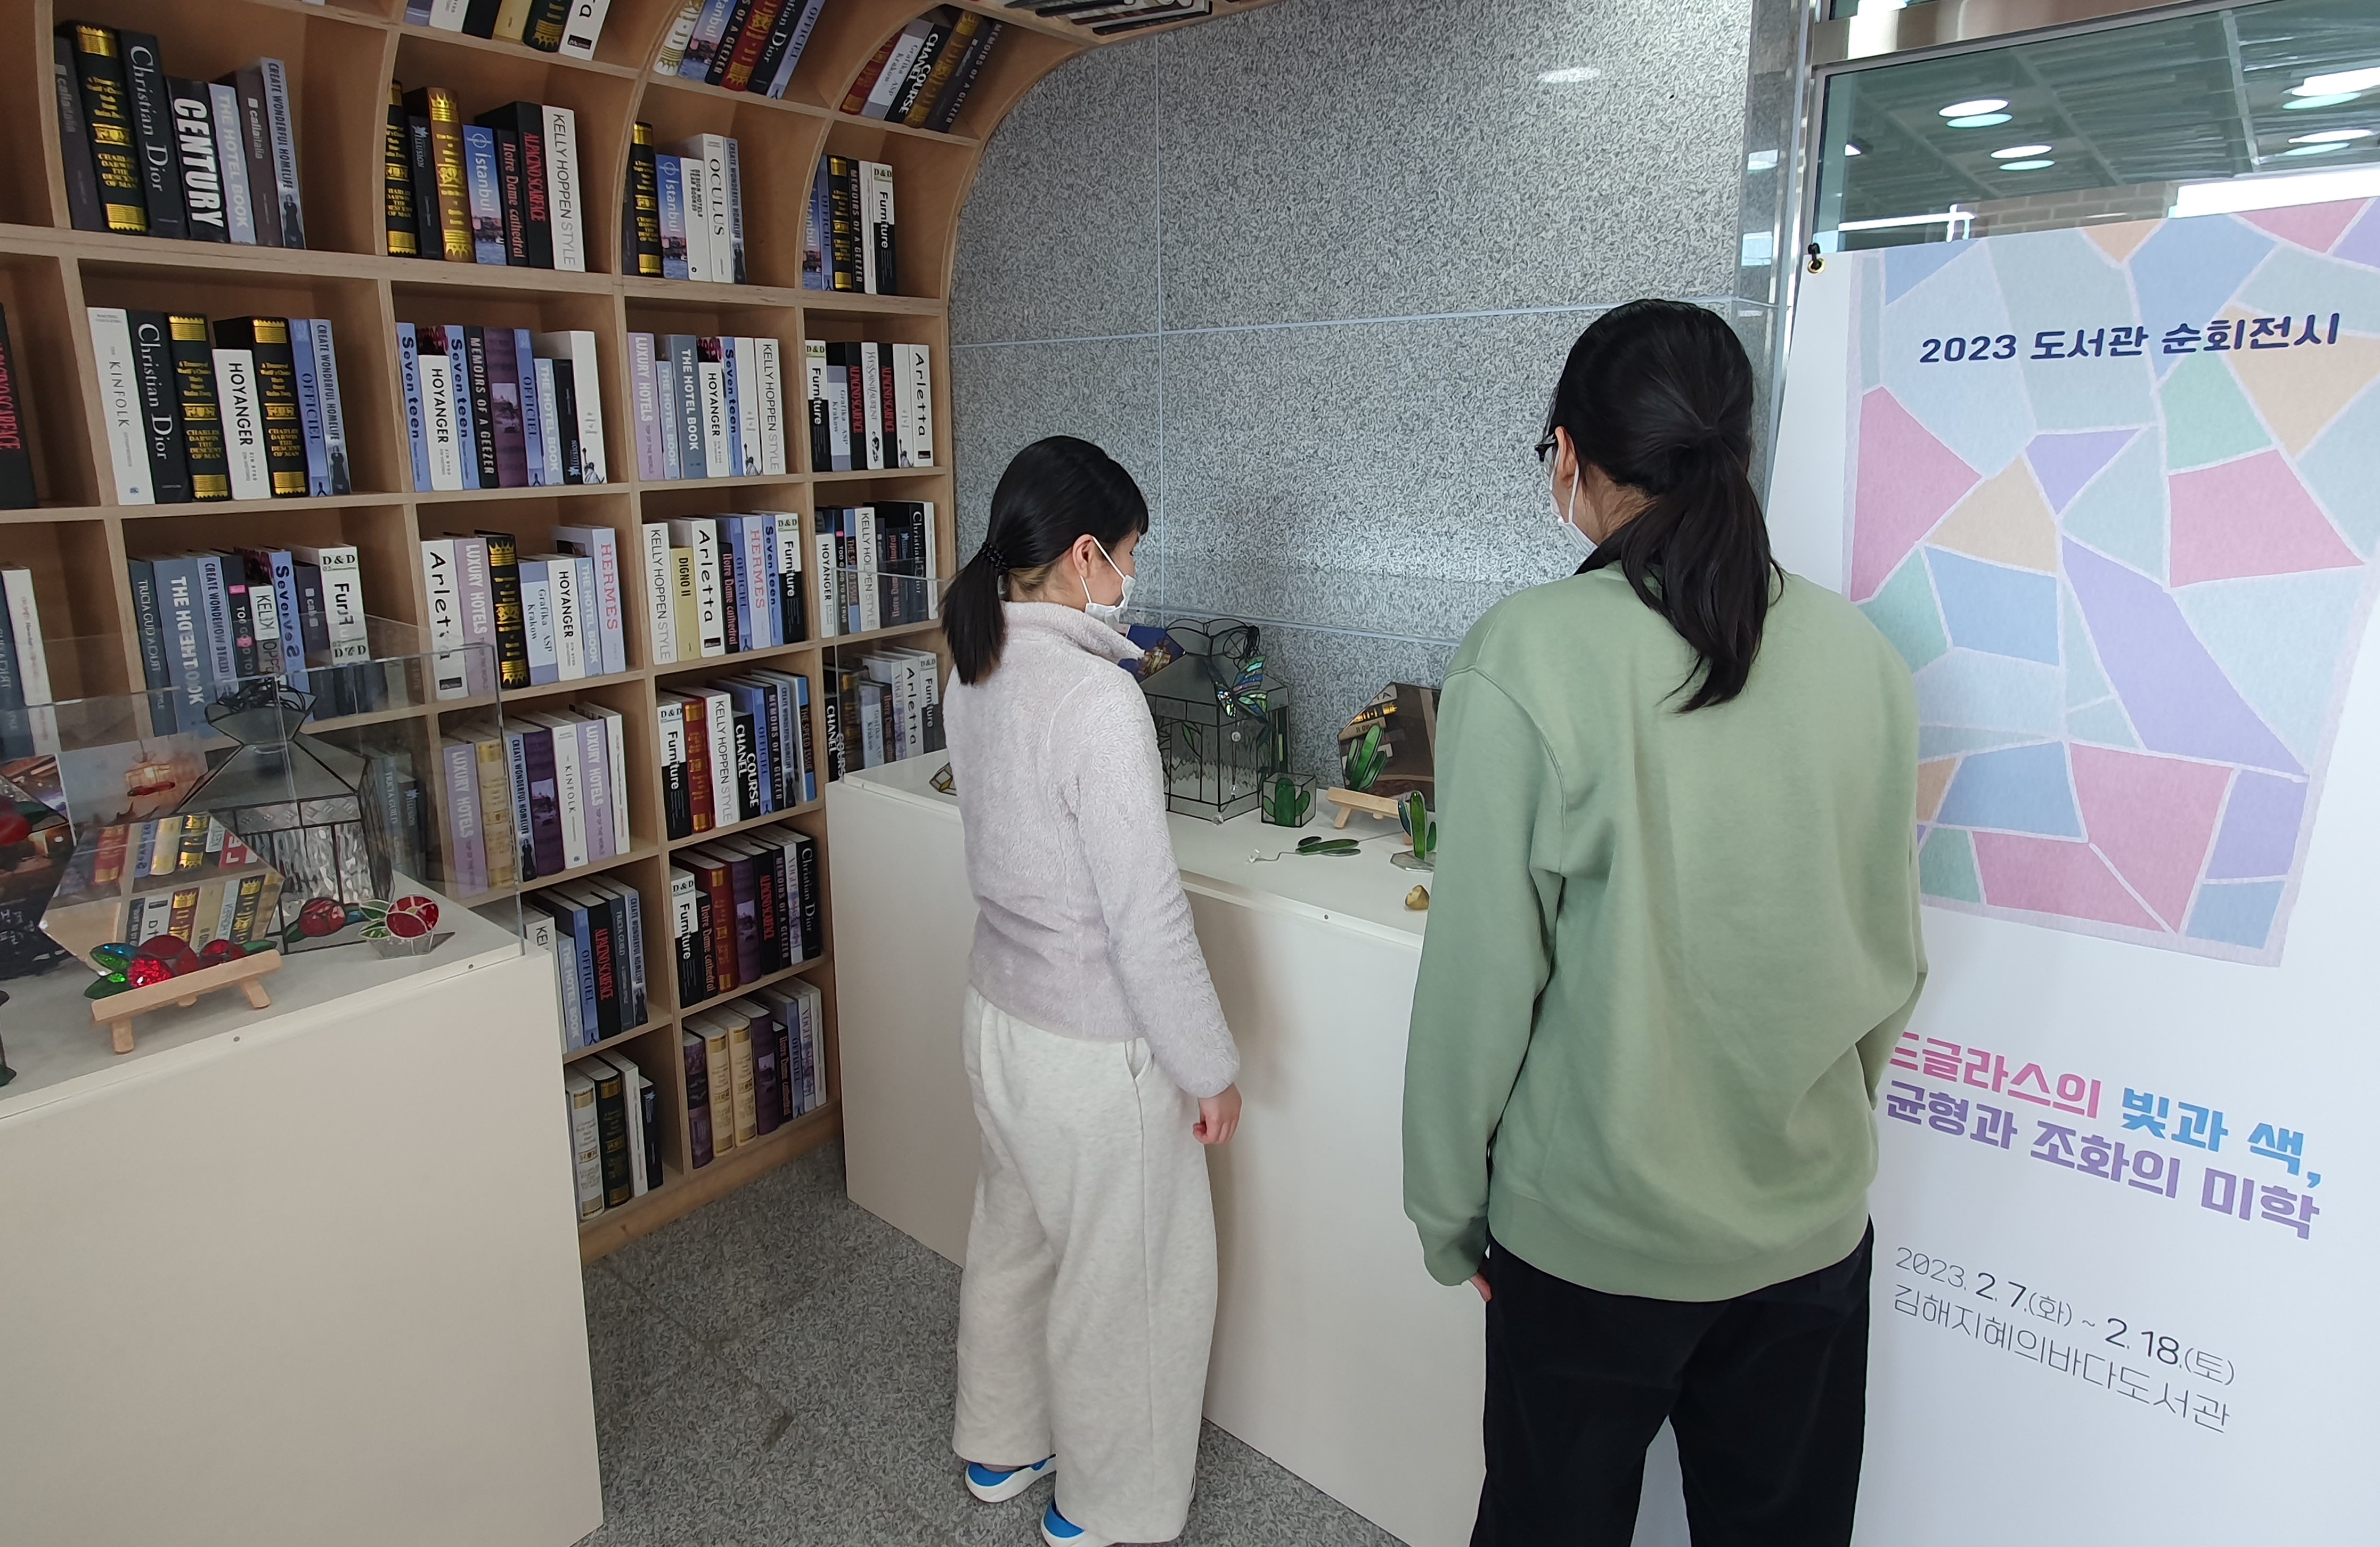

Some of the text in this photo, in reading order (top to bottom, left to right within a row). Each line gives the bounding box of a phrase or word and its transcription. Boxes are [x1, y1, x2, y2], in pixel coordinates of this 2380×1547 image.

[268, 63, 282, 92] CREATE
[764, 30, 787, 63] Dior
[906, 33, 939, 82] CHANEL
[976, 23, 1002, 66] MEMOIRS
[129, 45, 168, 192] Christian Dior
[899, 64, 931, 114] COURSE
[173, 97, 224, 227] CENTURY
[219, 93, 249, 228] THE HOTEL BOOK
[475, 151, 495, 211] Istanbul
[506, 175, 519, 206] Dame
[553, 113, 575, 266] KELLY HOPPEN STYLE
[850, 169, 859, 217] MEMOIRS
[665, 179, 680, 232] Istanbul
[710, 158, 725, 235] OCULUS
[879, 191, 890, 249] Furniture
[854, 247, 863, 283] GEEZER
[316, 324, 329, 352] CREATE
[470, 337, 486, 393] MEMOIRS
[1920, 313, 2340, 363] 2023 도서관 순회전시
[109, 360, 130, 428] KINFOLK
[137, 323, 173, 460] Christian Dior
[229, 363, 252, 446] HOYANGER
[302, 372, 321, 444] OFFICIEL
[432, 369, 449, 443] HOYANGER
[476, 399, 487, 413] OF
[635, 337, 653, 422] LUXURY HOTELS
[681, 349, 699, 451] THE HOTEL BOOK
[708, 373, 720, 436] HOYANGER
[763, 344, 779, 470] KELLY HOPPEN STYLE
[812, 368, 822, 425] Furniture
[915, 352, 926, 436] Arletta
[540, 365, 559, 473] THE HOTEL BOOK
[661, 368, 676, 467] THE HOTEL BOOK
[480, 431, 495, 474] GEEZER
[170, 576, 189, 607] THE
[466, 544, 487, 634] LUXURY HOTELS
[600, 543, 618, 630] HERMES
[651, 530, 671, 660] KELLY HOPPEN STYLE
[679, 558, 690, 587] DIGNO
[699, 530, 714, 622] Arletta
[724, 580, 734, 603] Dame
[750, 530, 765, 609] HERMES
[784, 541, 795, 597] Furniture
[822, 544, 832, 600] HOYANGER
[861, 513, 875, 626] KELLY STYLE
[538, 589, 553, 653] Grafika ASP
[559, 571, 574, 638] HOYANGER
[582, 564, 599, 663] THE HOTEL BOOK
[768, 694, 778, 738] MEMOIRS
[826, 705, 837, 756] CHANEL
[906, 667, 918, 745] Arletta
[586, 725, 604, 807] LUXURY HOTELS
[667, 731, 680, 790] Furniture
[715, 701, 733, 823] KELLY HOPPEN STYLE
[735, 724, 747, 778] CHANEL
[746, 753, 759, 809] COURSE
[452, 750, 474, 838] LUXURY HOTELS
[565, 765, 576, 813] KINFOLK
[802, 848, 816, 932] Christian Dior
[680, 903, 691, 959] Furniture
[1886, 1080, 2321, 1240] 균형과 조화의 미학
[2121, 1087, 2229, 1152] 빛과
[2247, 1122, 2322, 1189] 색,
[1894, 1284, 2230, 1434] 김해지혜의바다도서관
